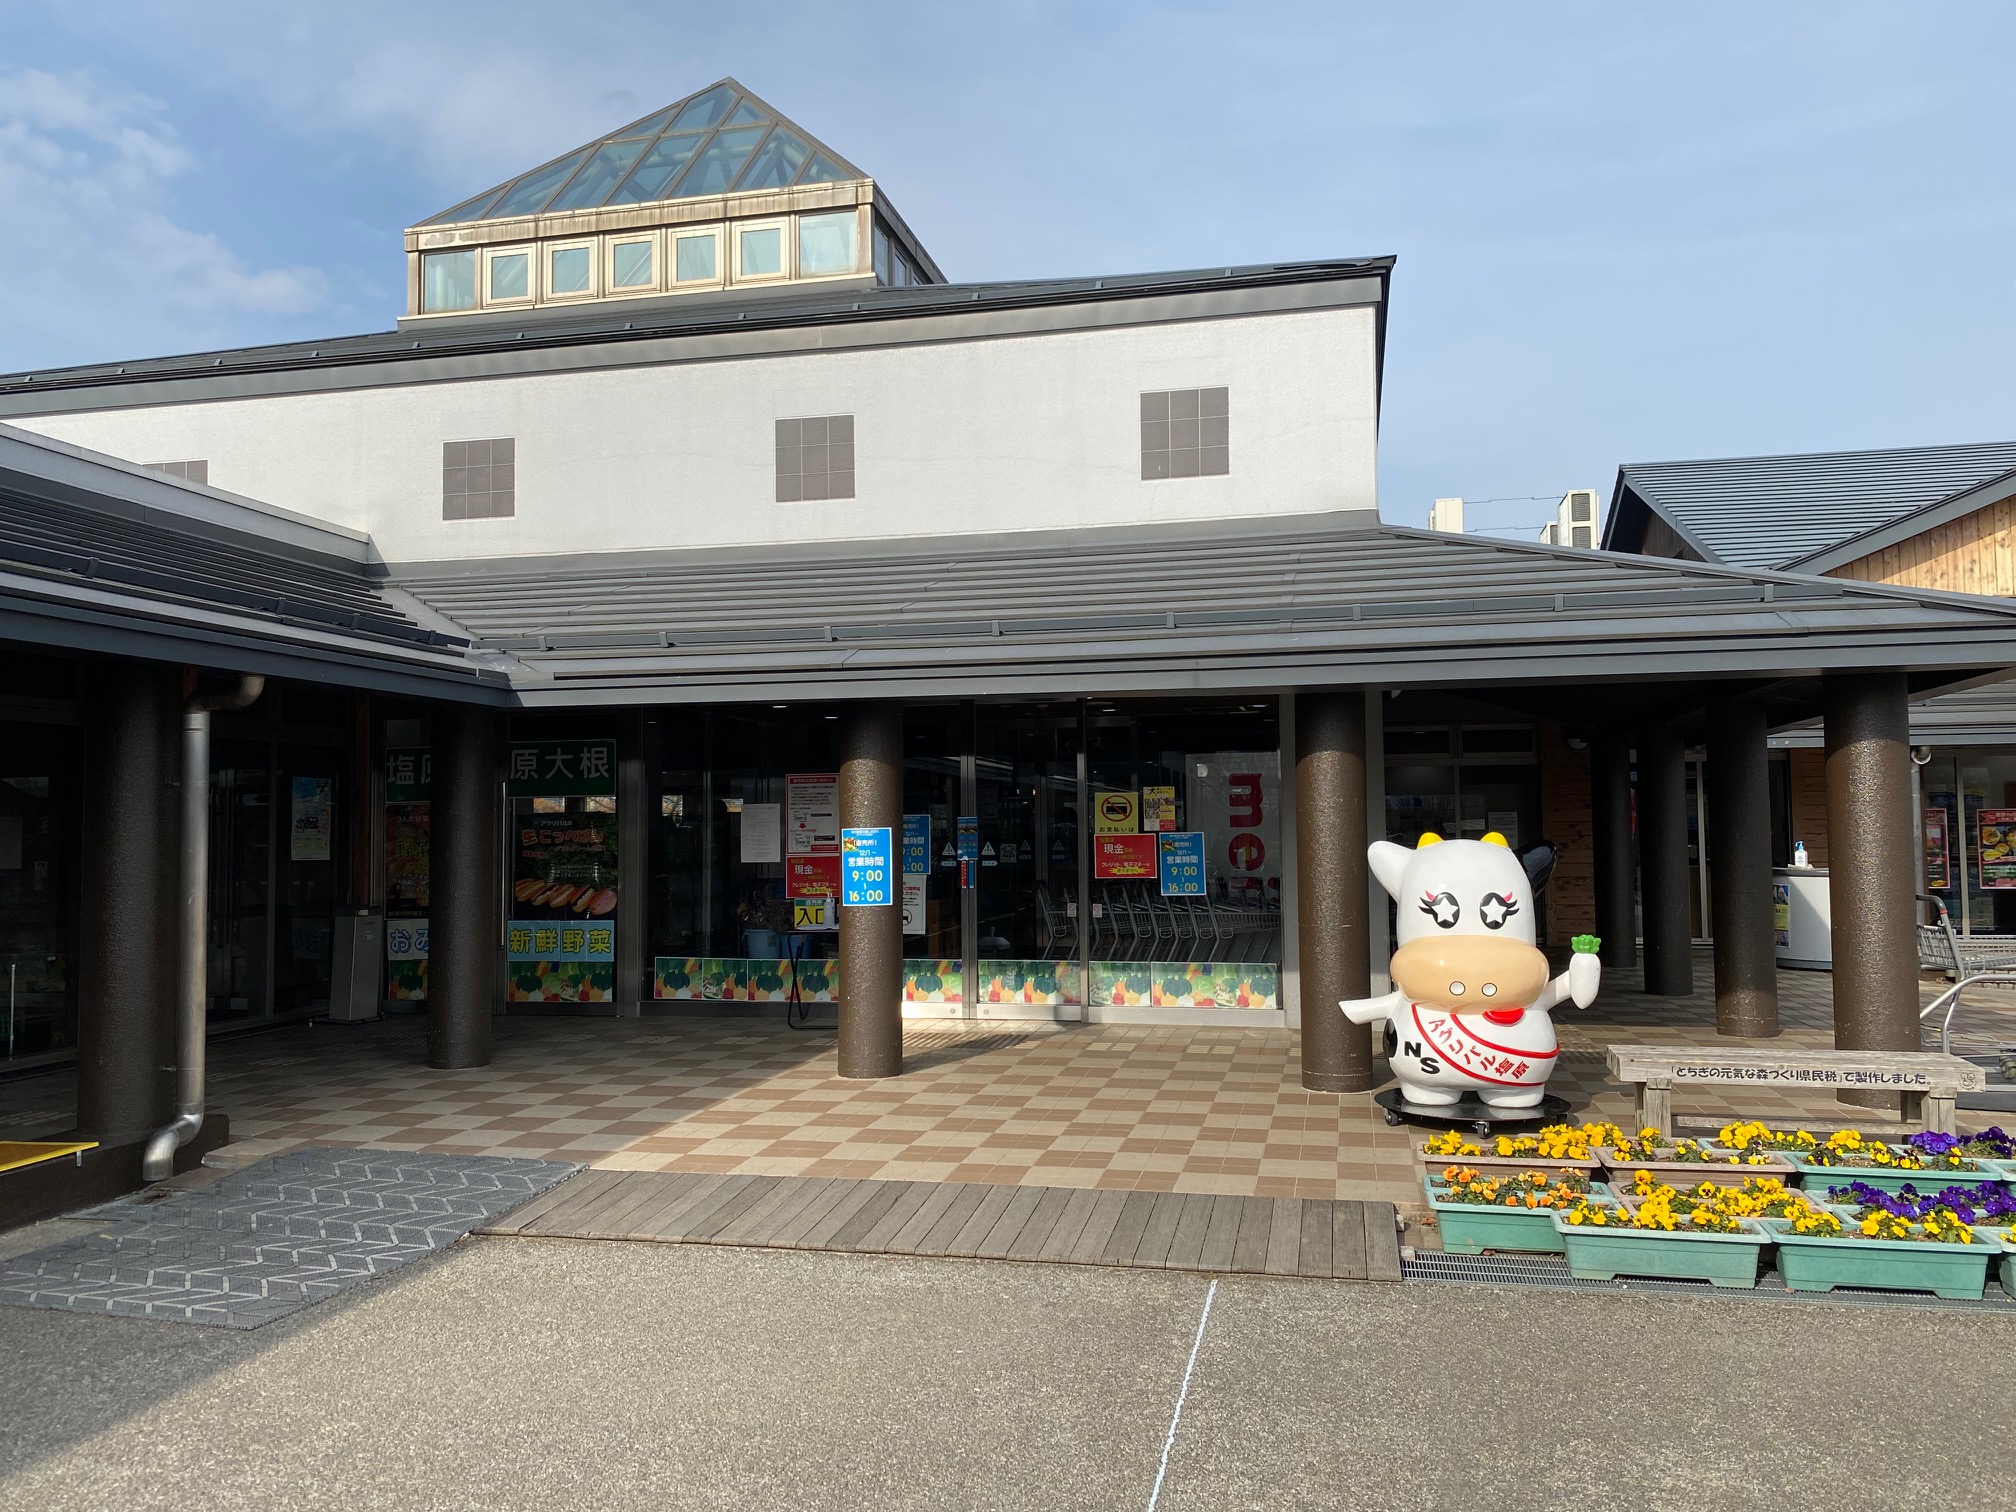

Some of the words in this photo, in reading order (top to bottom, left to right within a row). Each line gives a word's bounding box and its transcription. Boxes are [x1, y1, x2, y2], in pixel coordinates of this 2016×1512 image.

[510, 746, 610, 780] 原大根
[847, 856, 885, 867] 営業時間
[1166, 855, 1199, 865] 営業時間
[852, 870, 883, 882] 9:00
[1171, 866, 1198, 876] 9:00
[1168, 882, 1198, 893] 16:00
[848, 889, 883, 902] 16:00
[508, 928, 612, 954] 新鮮野菜
[1428, 1018, 1530, 1080] アグリパル塩原
[1671, 1065, 1932, 1086] 「とちぎの元気な森づくり県民税」で製作しました。
